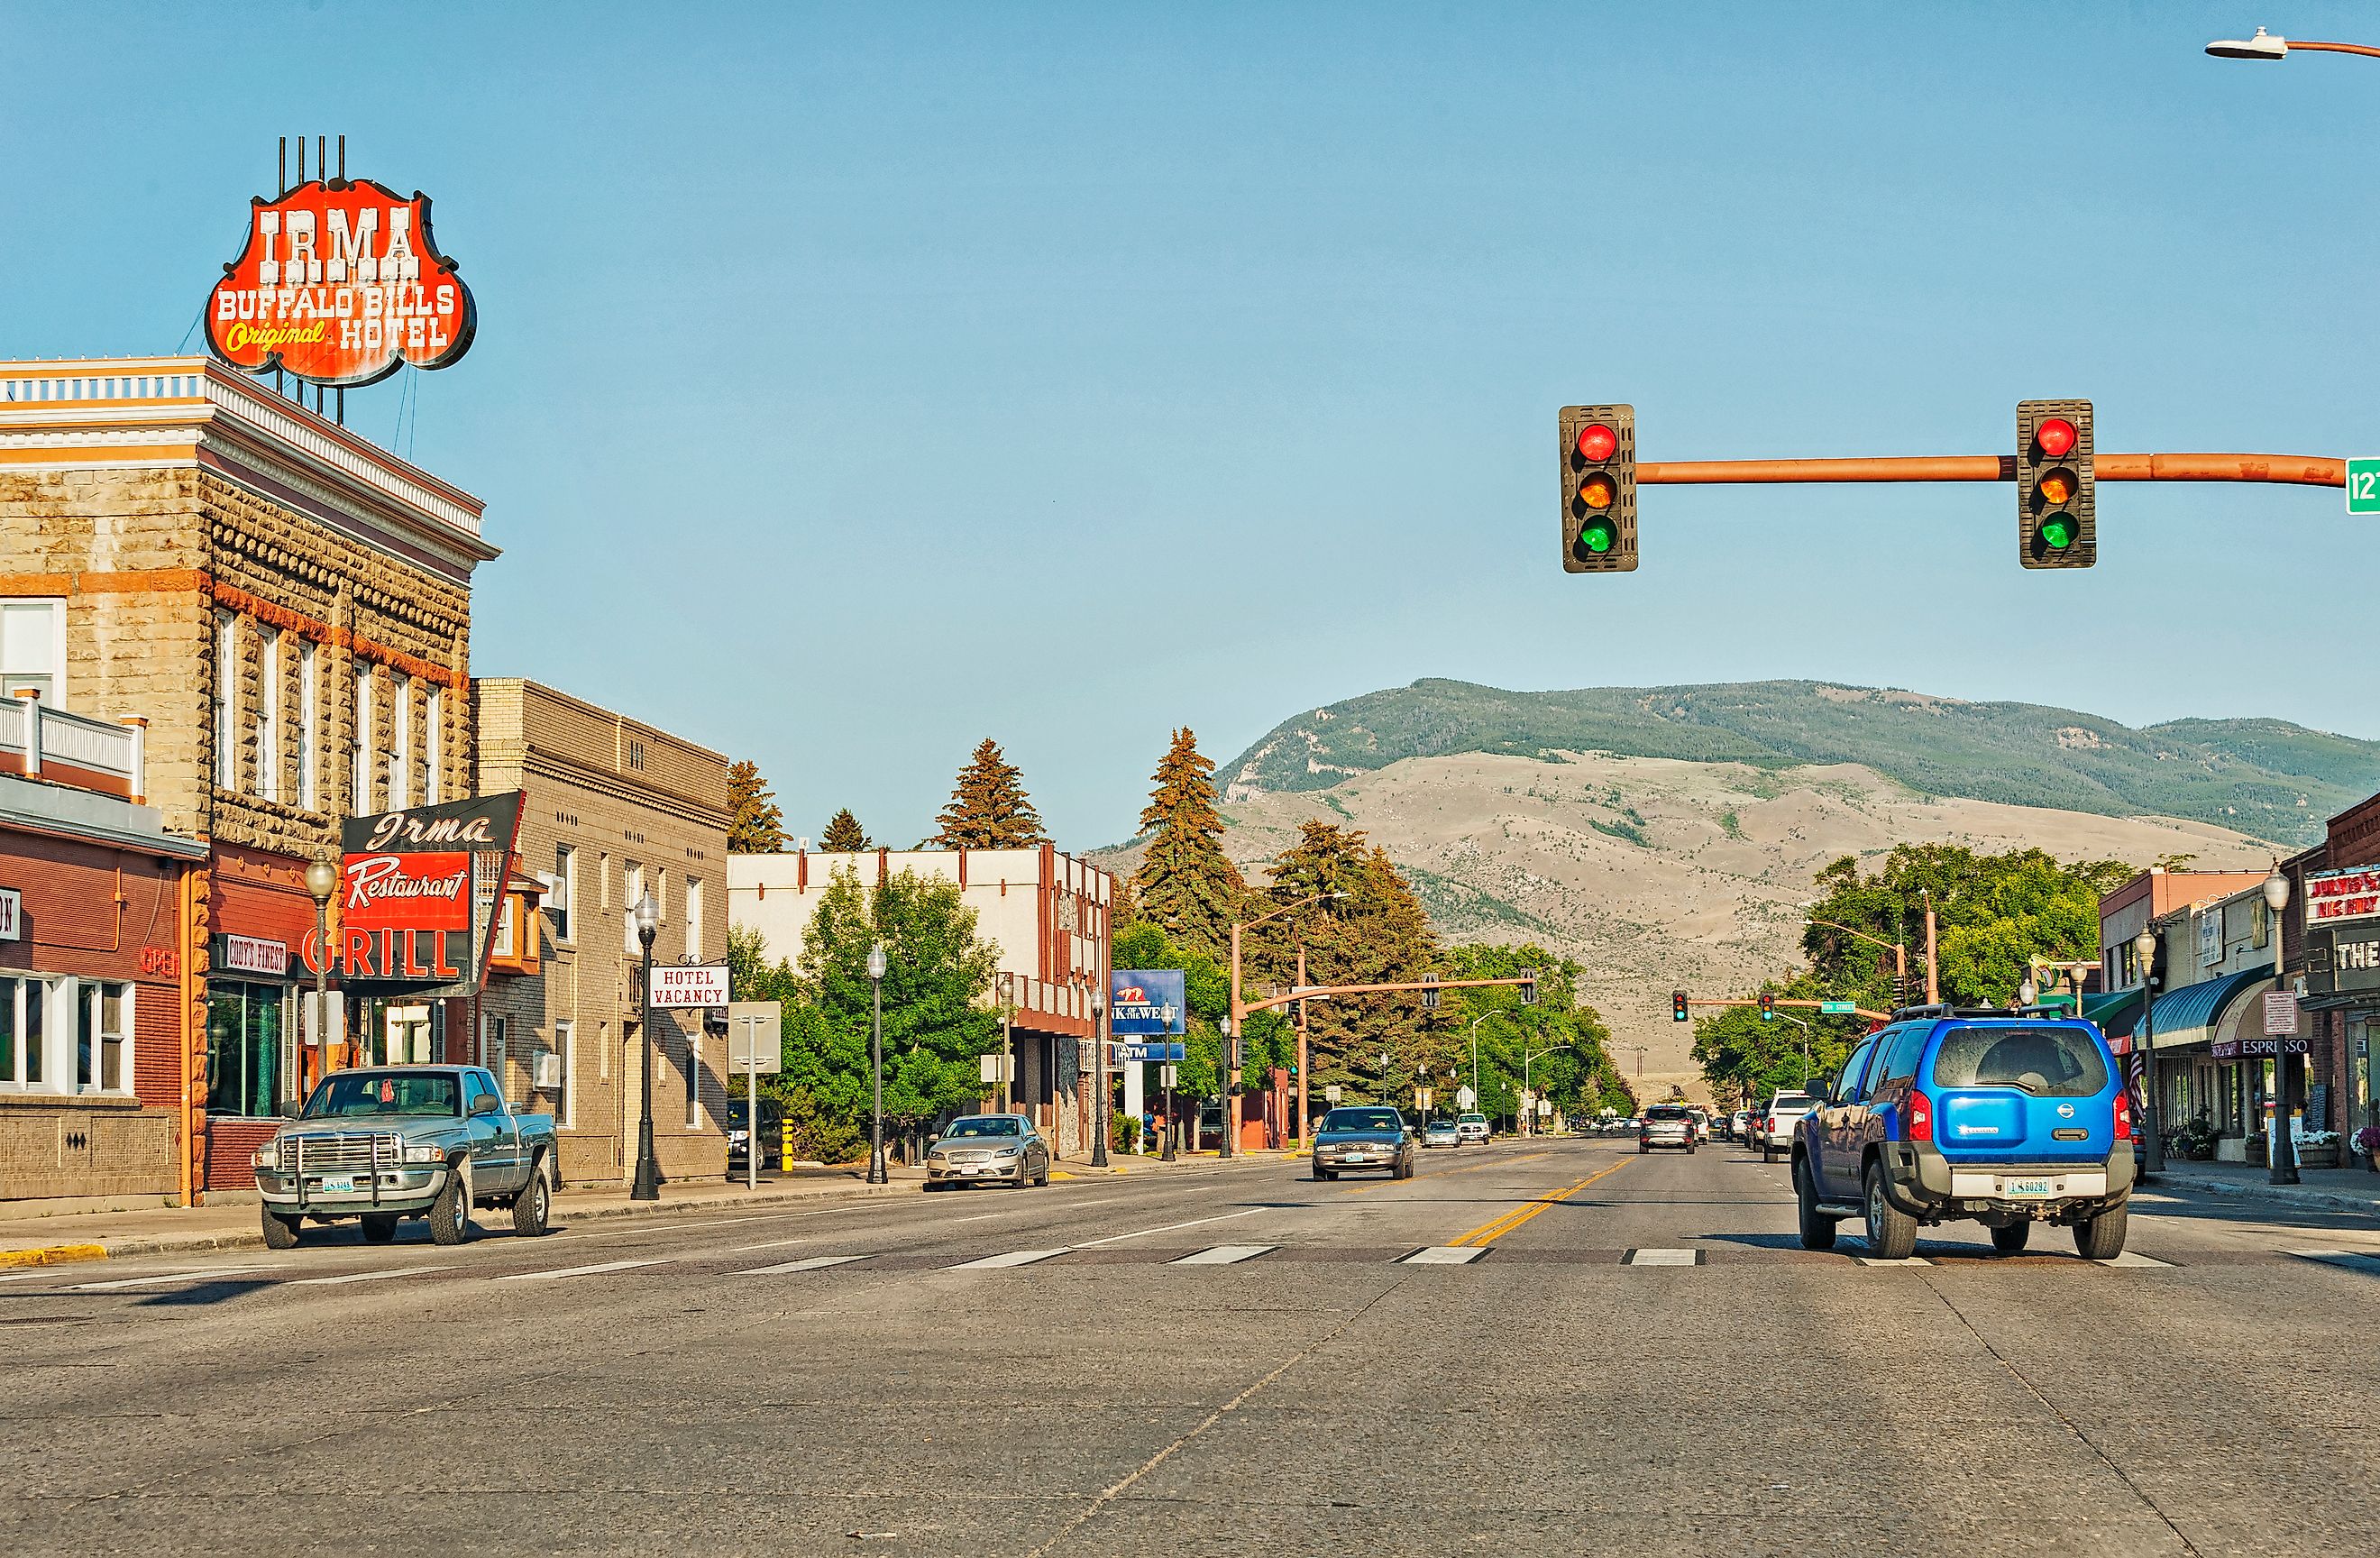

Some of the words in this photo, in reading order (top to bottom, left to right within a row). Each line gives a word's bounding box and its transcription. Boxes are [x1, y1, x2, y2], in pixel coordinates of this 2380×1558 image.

[259, 206, 420, 284] IRMA
[217, 287, 353, 321] BUFFALO
[364, 284, 454, 316] BILLS
[225, 320, 325, 353] Original
[339, 316, 448, 350] HOTEL
[364, 811, 497, 852] Irma
[347, 856, 468, 910] Restaurant
[229, 939, 254, 967] CODY'S
[258, 943, 284, 971] FINEST
[301, 926, 460, 978] GRILL
[664, 970, 714, 985] HOTEL
[654, 989, 723, 1004] VACANCY
[1140, 1006, 1178, 1020] WET
[2025, 1181, 2047, 1192] 60292
